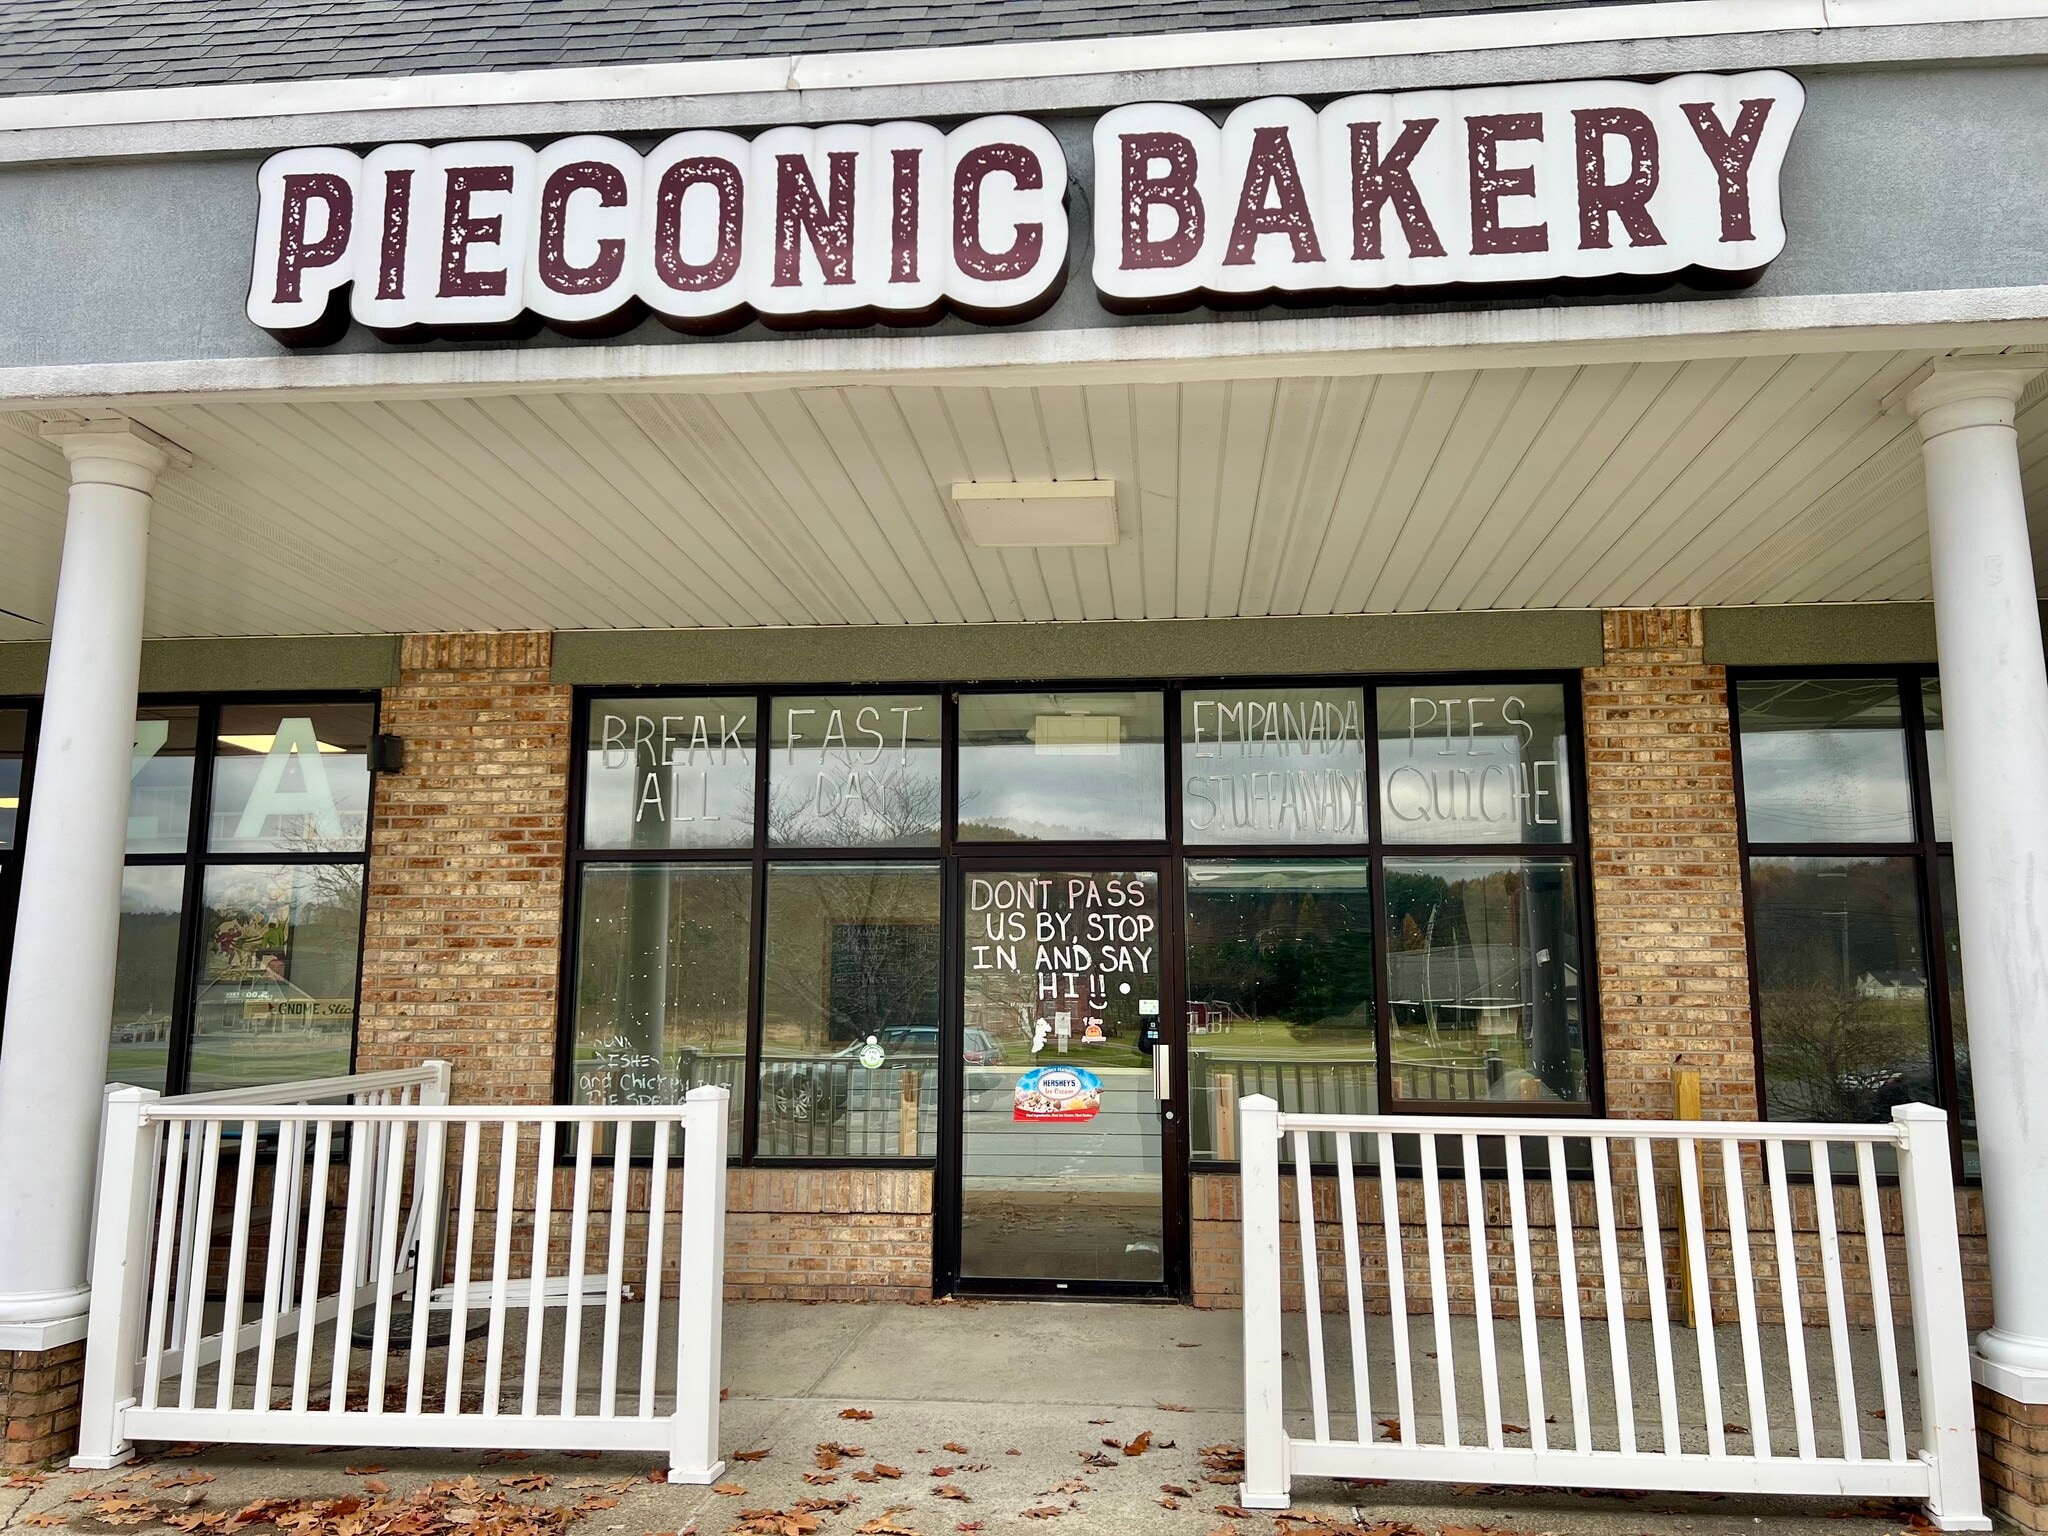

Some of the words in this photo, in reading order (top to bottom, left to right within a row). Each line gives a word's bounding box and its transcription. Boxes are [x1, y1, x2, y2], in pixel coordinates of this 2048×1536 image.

[273, 142, 1044, 304] PIECONIC
[1117, 98, 1776, 270] BAKERY
[602, 714, 750, 769] BREAK
[787, 706, 923, 765] FAST
[1193, 700, 1364, 759] EMPANADA
[1408, 696, 1534, 757] PIES
[636, 772, 720, 822] ALL
[815, 771, 898, 817] DAY
[1186, 768, 1368, 835] STUFFANADA
[1387, 760, 1558, 825] QUICHE
[971, 878, 1053, 911] DON'T
[1068, 879, 1146, 909] PASS
[986, 912, 1026, 941] US
[1036, 912, 1078, 944] BY,
[1087, 913, 1155, 942] STOP
[971, 945, 1018, 970] IN
[1035, 944, 1092, 971] AND
[1099, 945, 1152, 973] SAY
[278, 1002, 320, 1016] GNOME
[579, 1071, 612, 1090] and
